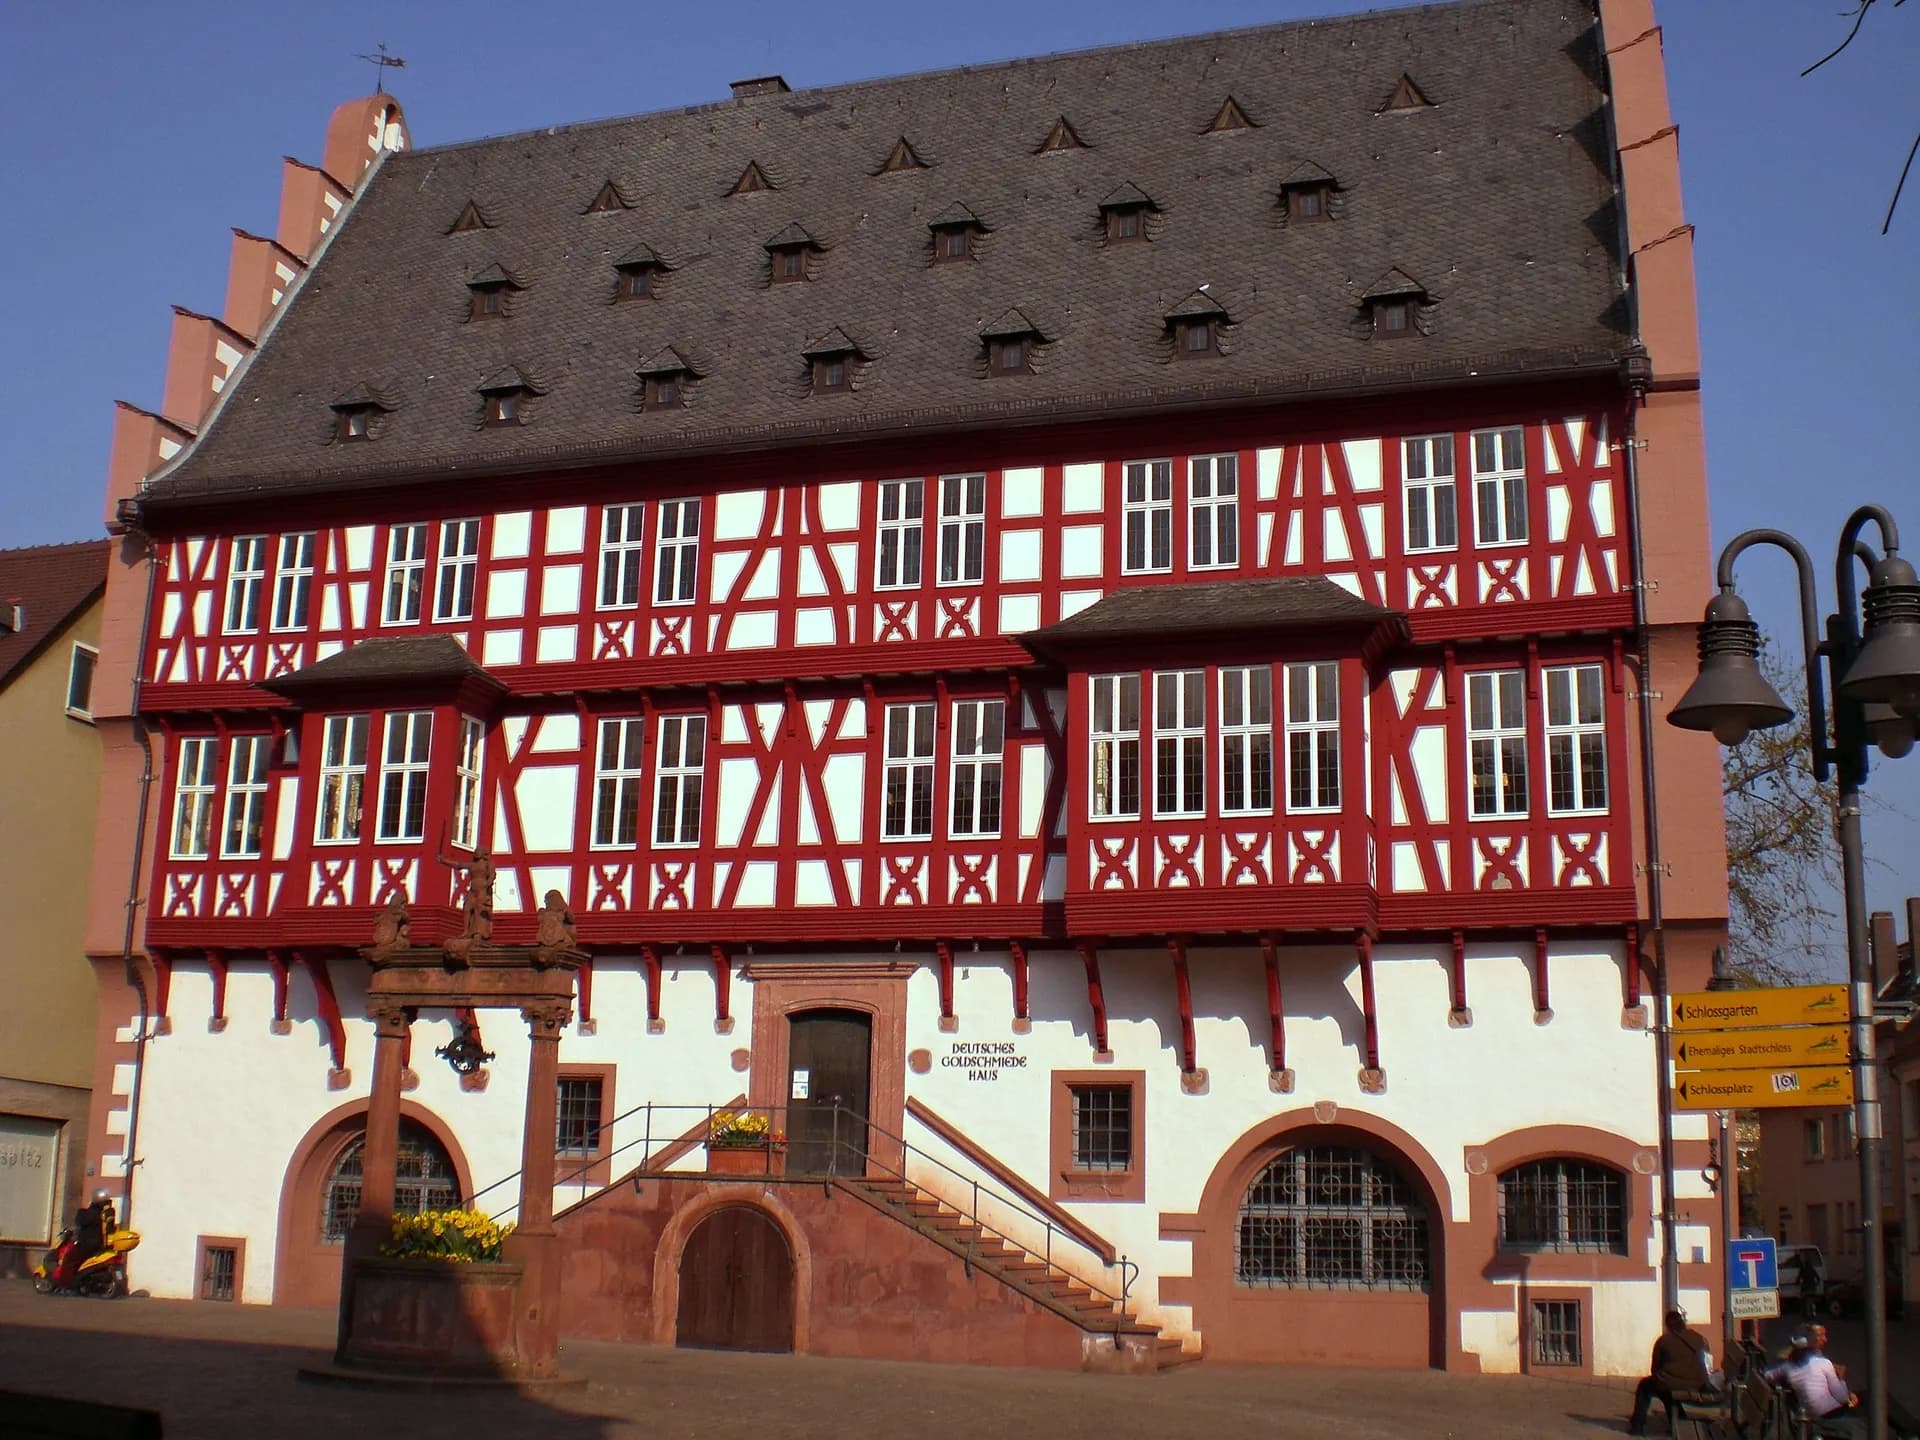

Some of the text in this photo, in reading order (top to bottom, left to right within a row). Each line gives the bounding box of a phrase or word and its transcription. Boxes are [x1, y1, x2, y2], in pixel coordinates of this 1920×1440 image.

[1686, 1003, 1758, 1020] Schlossgarten
[952, 1043, 1015, 1054] DEUTSCHES
[1688, 1044, 1735, 1058] Ehemaliges
[1739, 1043, 1792, 1055] Stadtschloss
[941, 1056, 1027, 1068] GOLDSCHMIEDE
[968, 1070, 998, 1081] HAUS
[1690, 1083, 1753, 1096] Schlossplatz
